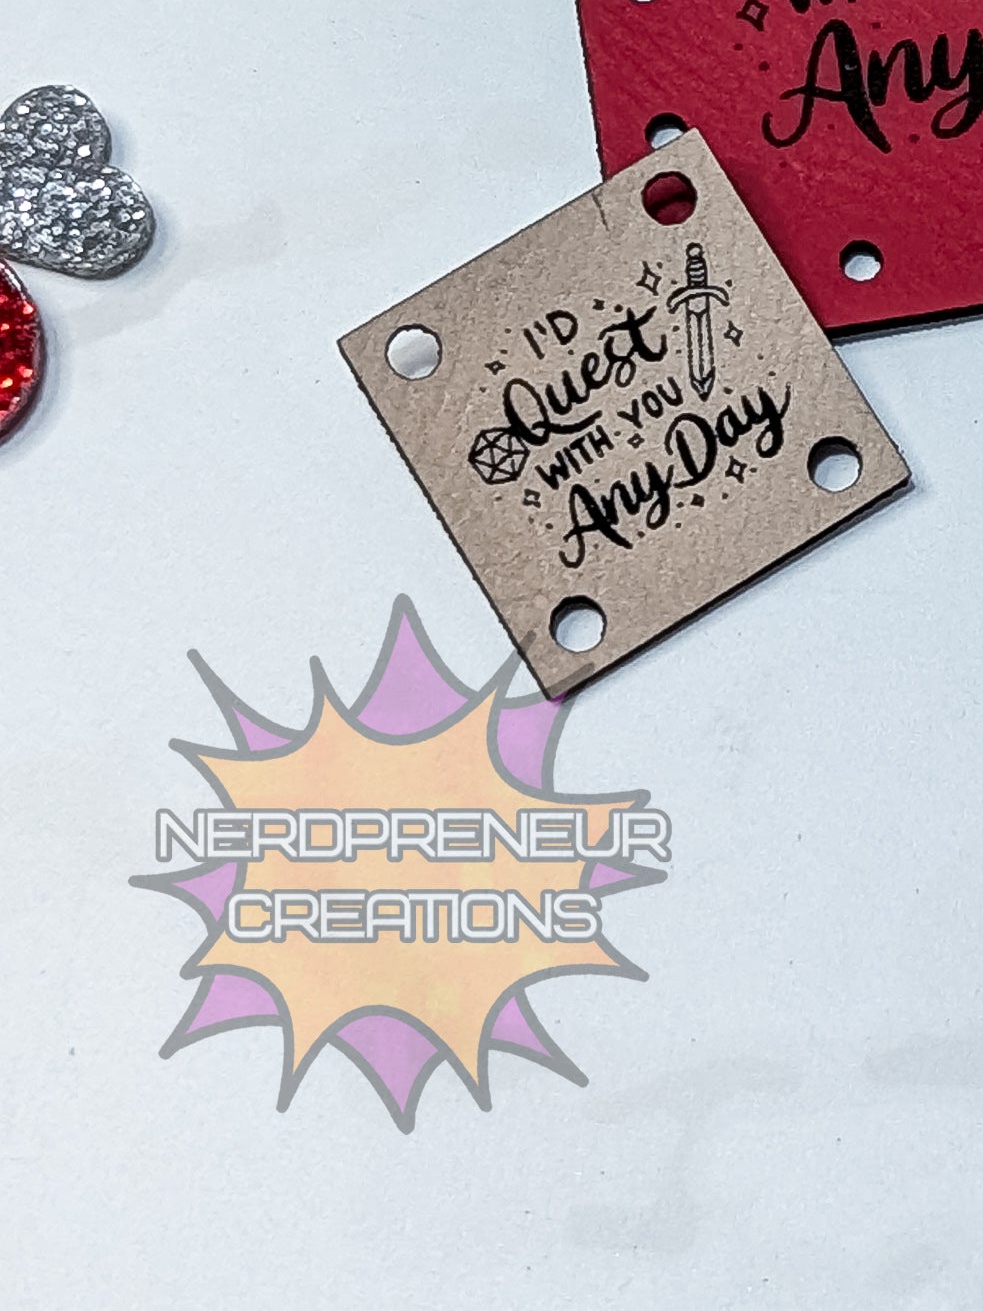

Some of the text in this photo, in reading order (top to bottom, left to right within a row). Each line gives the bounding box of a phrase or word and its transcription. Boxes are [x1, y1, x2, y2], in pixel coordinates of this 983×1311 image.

[503, 306, 668, 445] Quest
[523, 310, 578, 360] I'D
[535, 377, 684, 490] WITH YOU
[559, 382, 792, 568] Any Day
